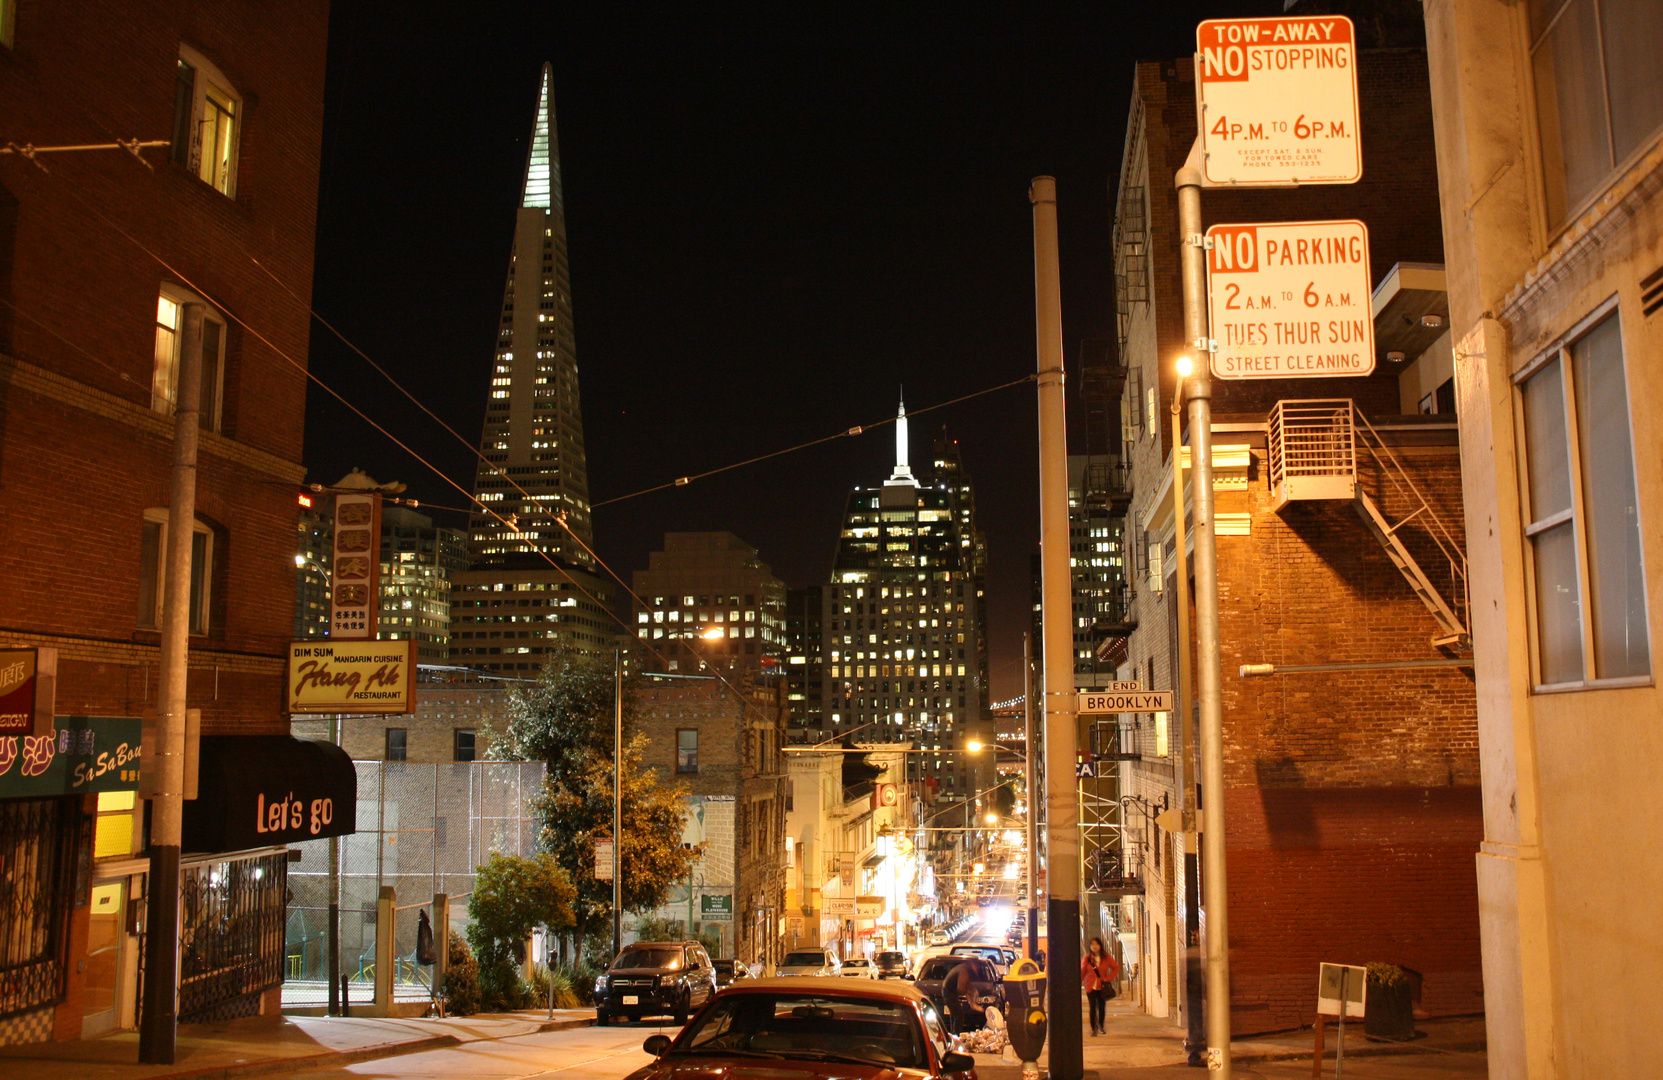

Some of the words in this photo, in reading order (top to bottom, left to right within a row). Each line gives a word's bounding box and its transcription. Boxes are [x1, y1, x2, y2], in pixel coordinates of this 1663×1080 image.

[1213, 22, 1335, 44] TOW-AWAY
[1204, 45, 1244, 77] NO
[1251, 47, 1347, 71] STOPPING
[1272, 121, 1287, 133] TO
[1214, 232, 1255, 270] NO
[1266, 236, 1361, 267] PARKING
[1281, 291, 1293, 301] TO
[1224, 323, 1267, 347] TUES
[1274, 321, 1321, 345] THUR
[1328, 320, 1364, 344] SUN
[1226, 356, 1280, 372] STREET
[1287, 353, 1360, 370] CLEANING
[294, 648, 312, 658] DIM
[313, 648, 334, 657] SUM
[334, 655, 372, 663] MANDARIN
[374, 654, 403, 663] CUISINE
[295, 660, 362, 699] Hang
[364, 664, 400, 697] Ah
[1112, 682, 1138, 690] END
[353, 691, 402, 700] RESTAURANT
[1087, 696, 1162, 709] BROOKLYN
[257, 791, 303, 834] Let's
[310, 796, 333, 836] go
